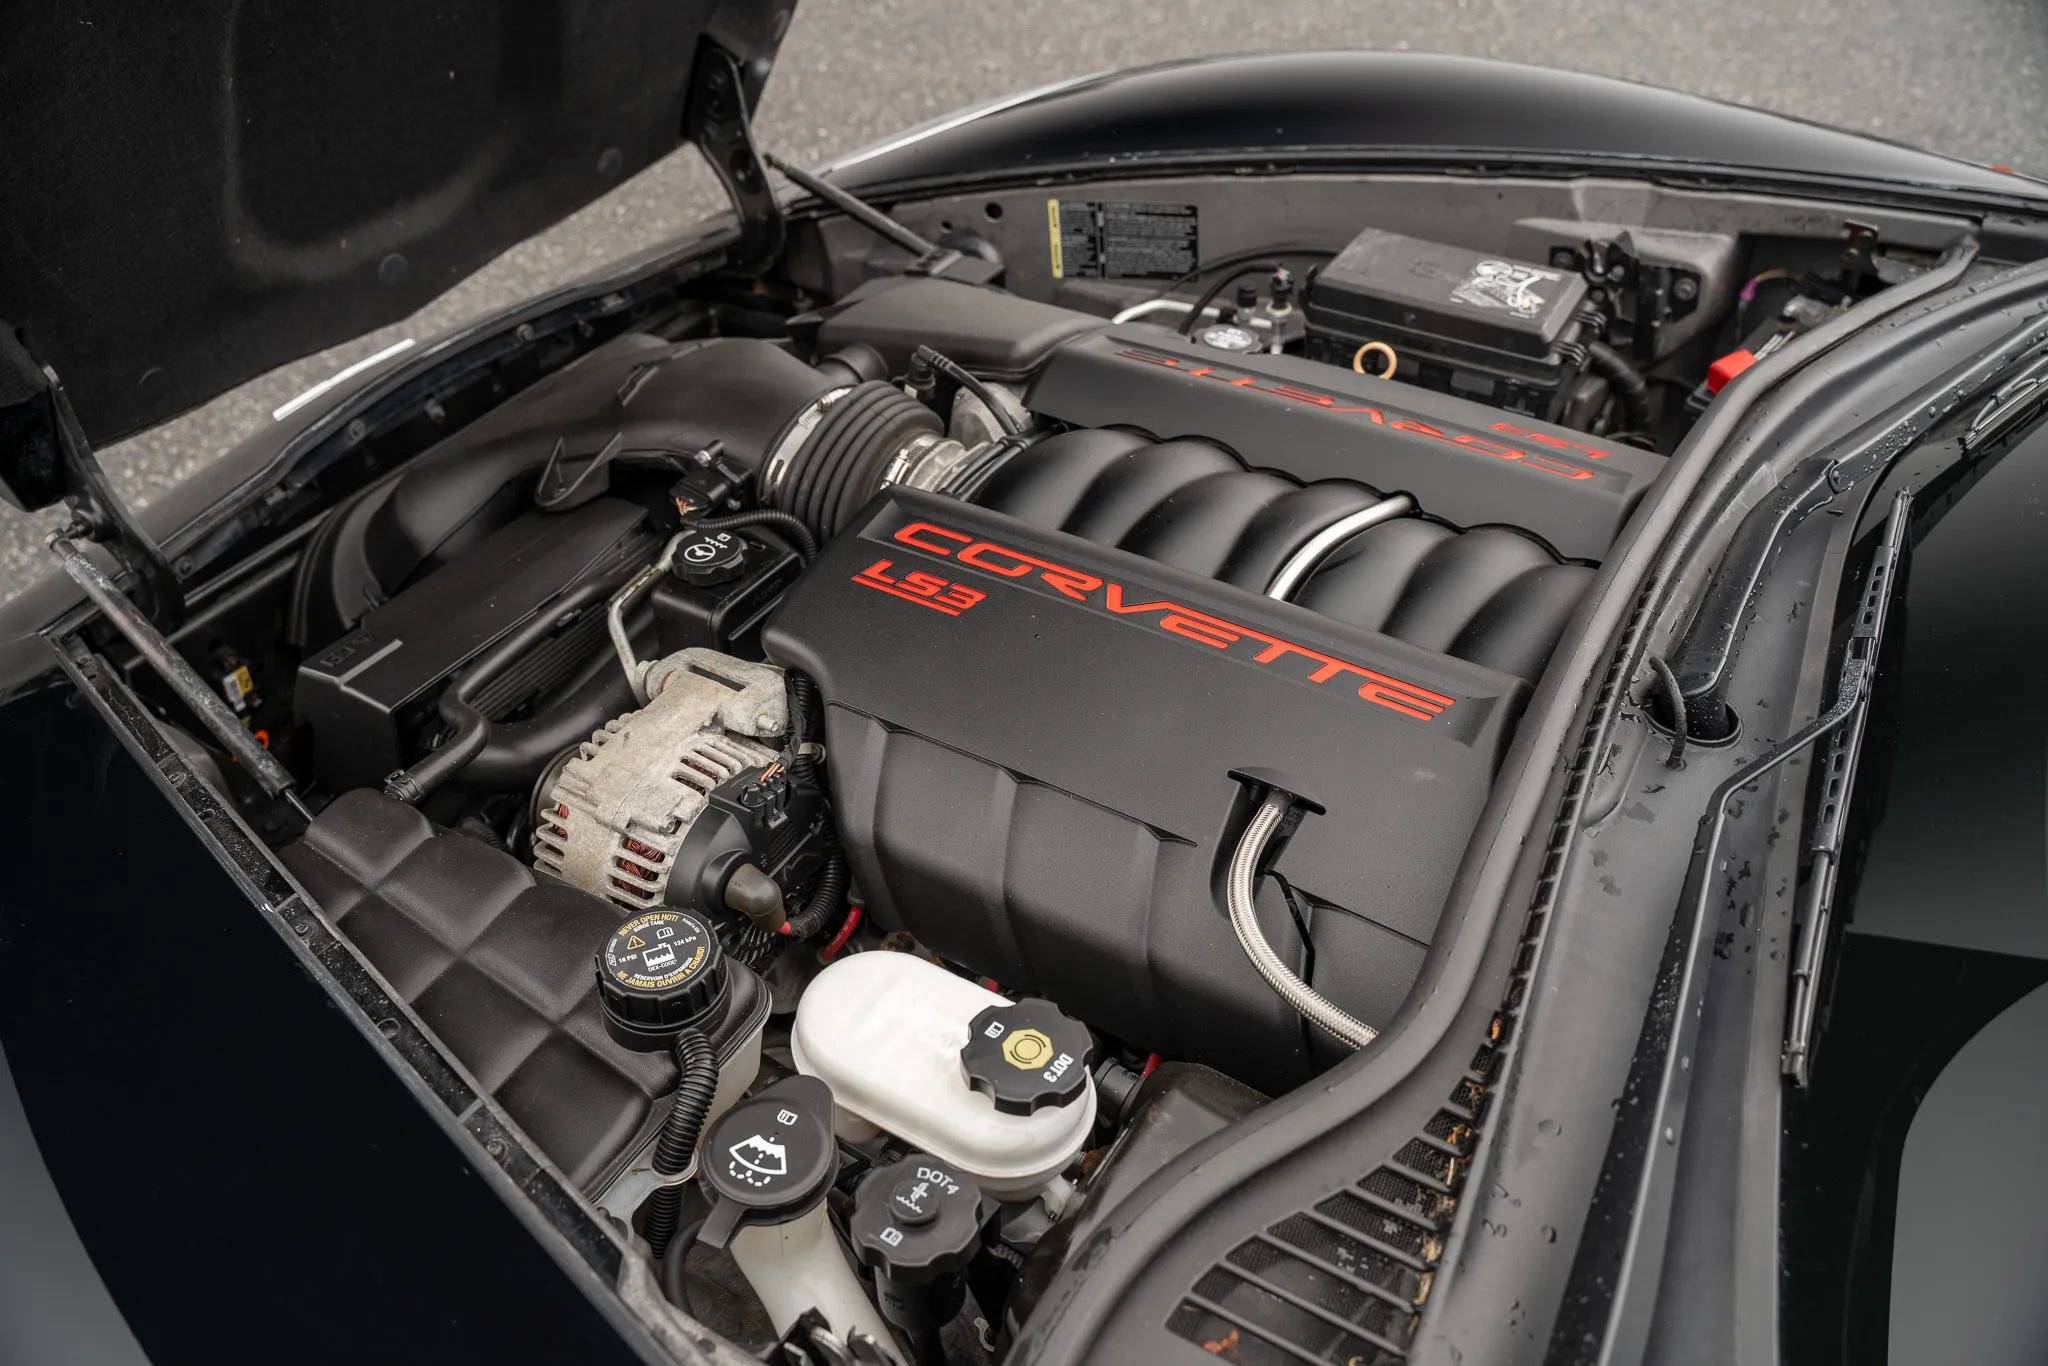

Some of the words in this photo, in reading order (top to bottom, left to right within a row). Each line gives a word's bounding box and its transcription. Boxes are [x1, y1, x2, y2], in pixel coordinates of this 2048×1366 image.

[851, 558, 988, 616] LS3
[894, 521, 1456, 721] CORVETTE
[618, 919, 640, 937] NEVER
[641, 913, 660, 924] OPEN
[661, 913, 679, 922] HOT!
[633, 922, 650, 933] SURGE
[685, 935, 697, 944] kPa
[616, 970, 629, 980] NE
[626, 974, 656, 989] JAMAIS
[656, 972, 686, 987] OUVRIR
[691, 946, 705, 970] CHAUD!
[627, 953, 637, 962] PSI
[1042, 1053, 1074, 1083] DOT3
[916, 1166, 960, 1196] DOT4
